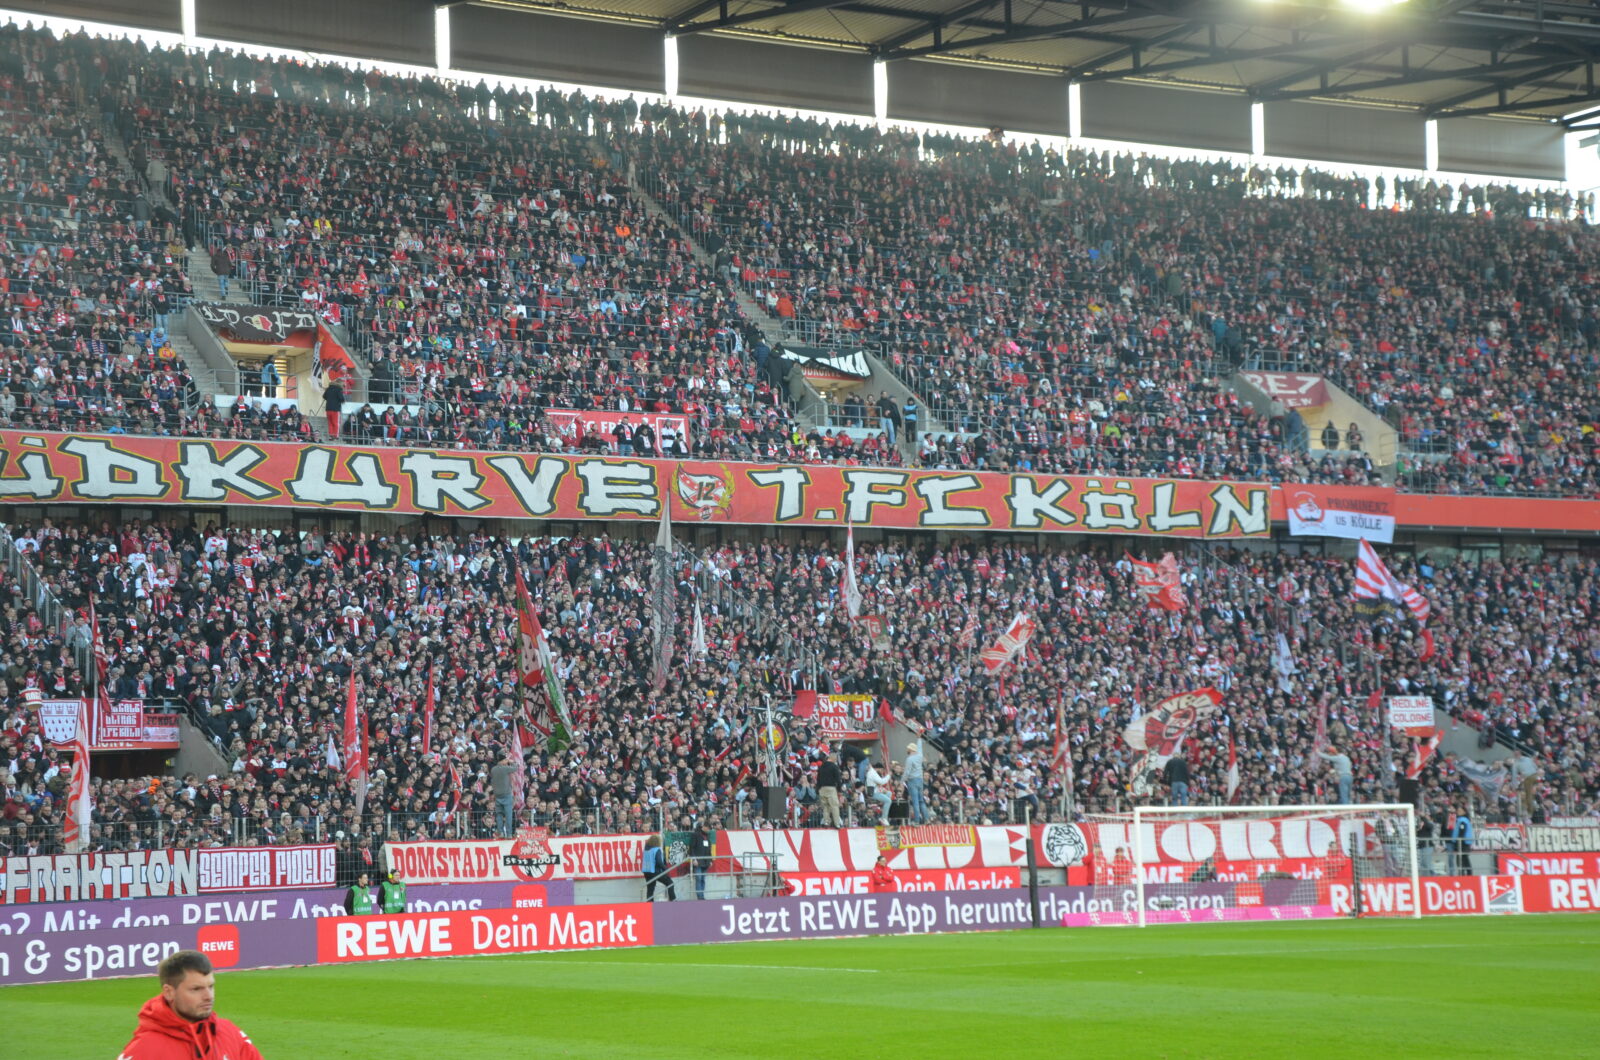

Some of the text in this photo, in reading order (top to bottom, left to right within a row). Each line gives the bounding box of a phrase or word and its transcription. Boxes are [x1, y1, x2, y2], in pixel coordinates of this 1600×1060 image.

[1005, 473, 1270, 537] KÖLN
[1326, 497, 1390, 513] PROMINENZ
[1350, 514, 1383, 530] KÖLLE
[1391, 698, 1430, 708] REDLINE
[1393, 713, 1432, 722] COLOGNE
[900, 825, 972, 846] STADIONVERBOT
[200, 848, 336, 888] SEMPER FIDELIS
[391, 846, 501, 878] DOMSTADT
[516, 899, 543, 908] REWE
[1424, 880, 1476, 912] Dein
[720, 904, 791, 936] Jetzt
[799, 898, 880, 932] REWE
[887, 897, 938, 933] App
[202, 940, 234, 952] REWE
[336, 910, 638, 957] REWE Dein Markt
[24, 939, 51, 975] &
